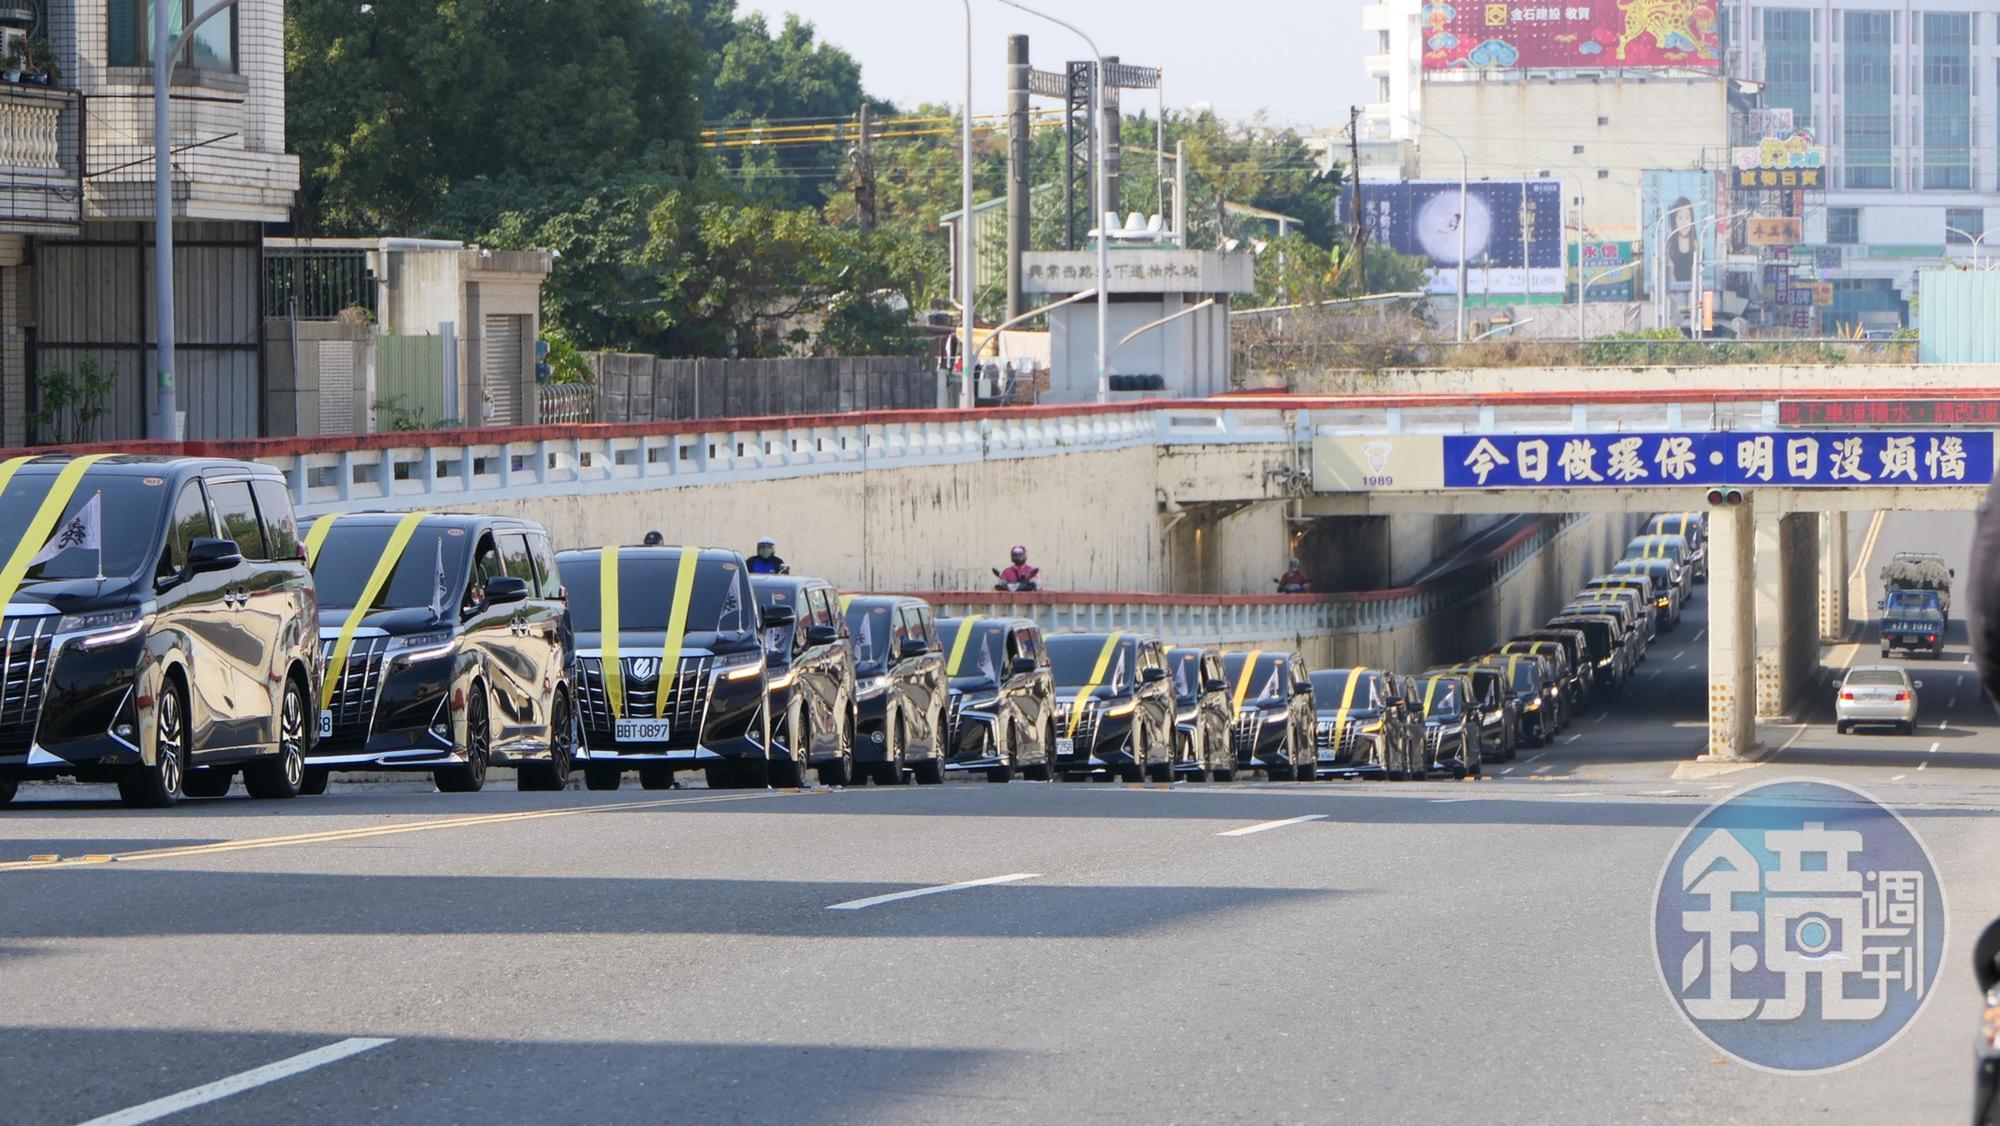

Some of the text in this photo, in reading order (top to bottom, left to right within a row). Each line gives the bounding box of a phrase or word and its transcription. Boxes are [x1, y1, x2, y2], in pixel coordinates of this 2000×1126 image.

[1510, 7, 1590, 21] 金石建設 敬賀
[1362, 476, 1393, 486] 1989
